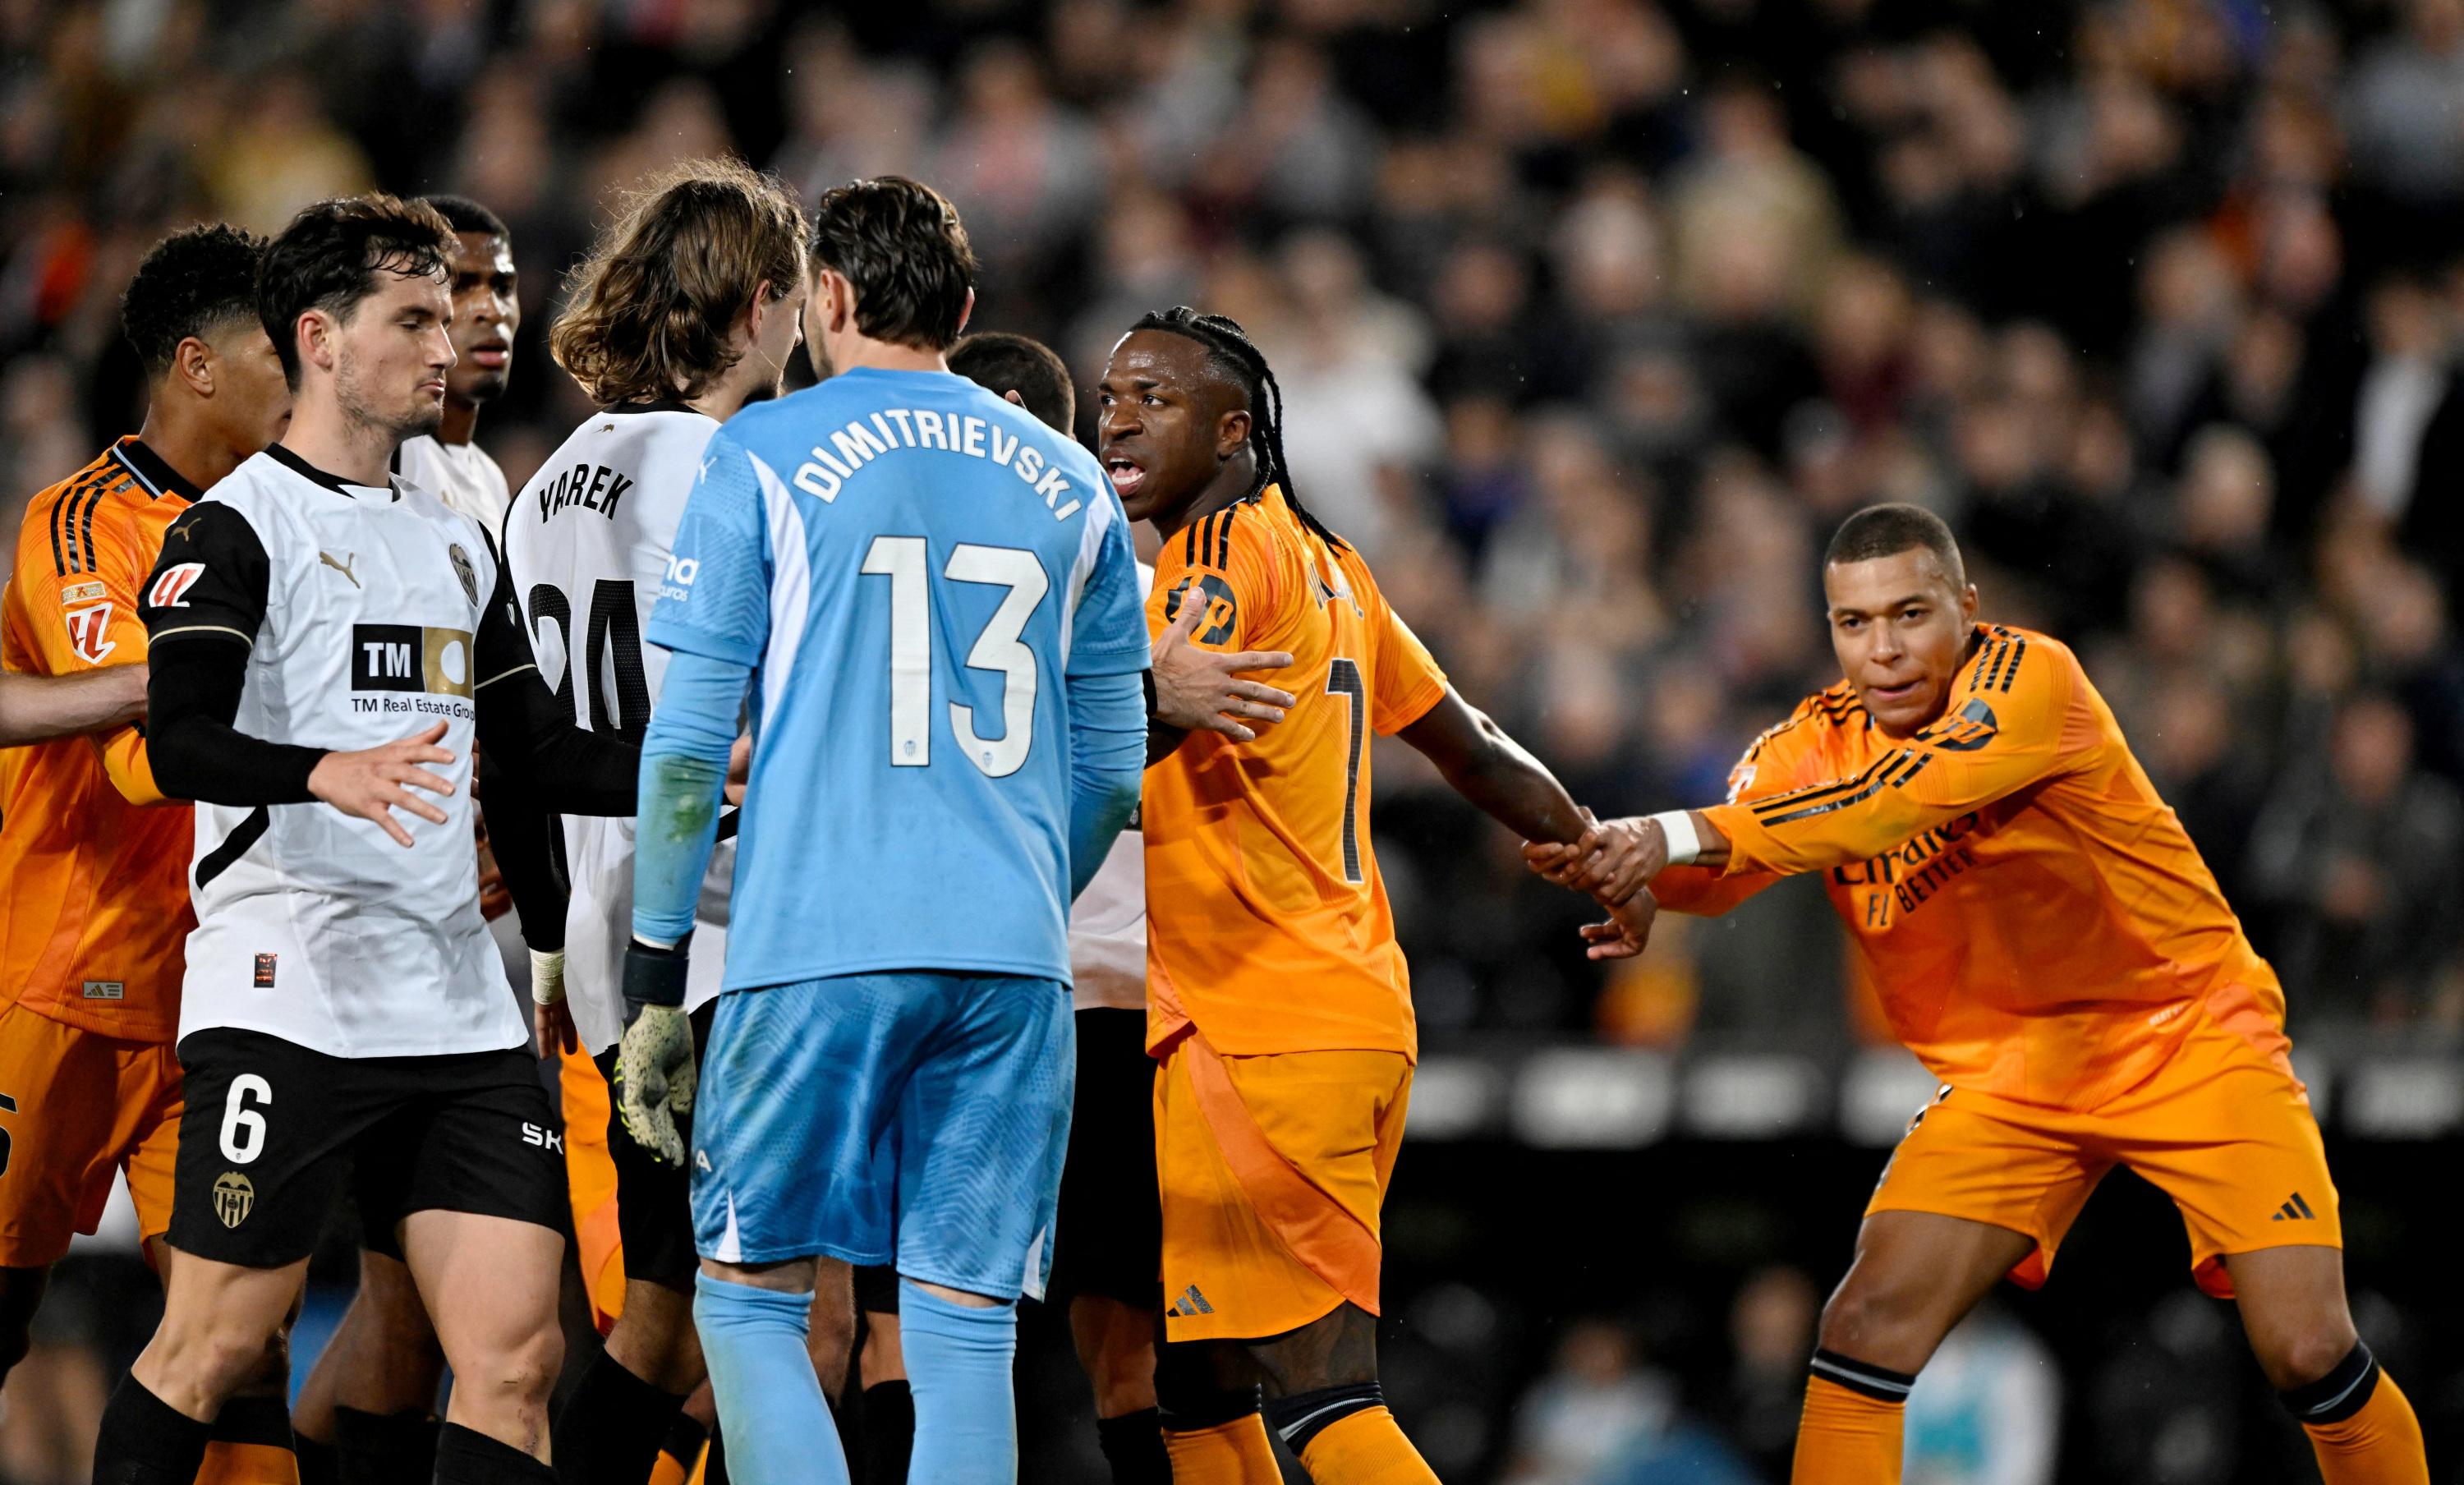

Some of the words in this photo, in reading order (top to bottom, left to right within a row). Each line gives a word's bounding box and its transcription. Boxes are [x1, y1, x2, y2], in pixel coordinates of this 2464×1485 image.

[539, 463, 634, 524] YAREK
[793, 408, 1083, 522] DIMITRIEVSKI
[363, 642, 411, 678] TM
[528, 578, 651, 743] 24
[860, 536, 1050, 779] 13
[352, 698, 378, 712] TM
[384, 697, 412, 712] Real
[416, 698, 451, 715] Estate
[453, 703, 475, 724] Grop
[1894, 848, 1979, 913] BETTER
[219, 1073, 272, 1164] 6
[522, 1122, 563, 1155] SK
